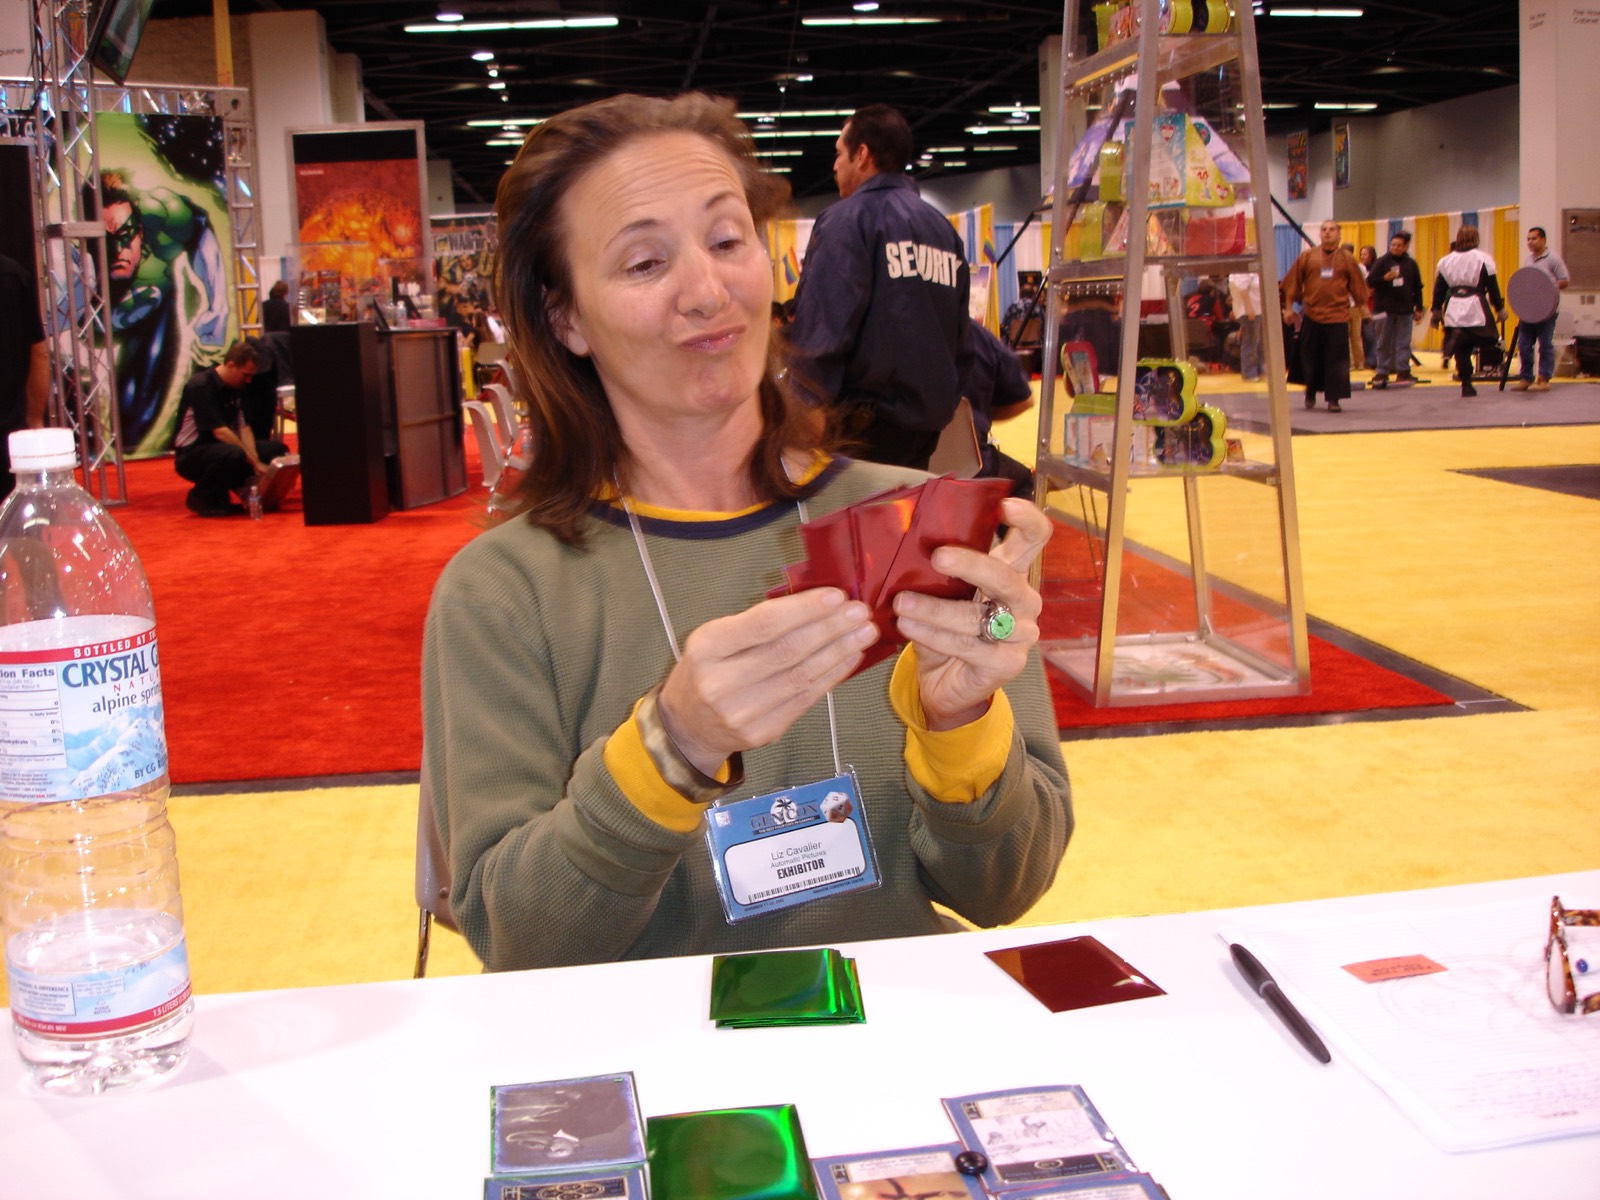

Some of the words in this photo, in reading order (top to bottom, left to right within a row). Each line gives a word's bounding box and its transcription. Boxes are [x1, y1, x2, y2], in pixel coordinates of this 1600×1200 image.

[73, 640, 131, 658] BOTTLED
[136, 636, 146, 646] AT
[22, 668, 55, 678] Facts
[62, 650, 149, 688] CRYSTAL
[92, 693, 137, 714] alpine
[134, 769, 144, 779] BY
[146, 762, 156, 774] CG
[770, 851, 784, 861] Liz
[786, 841, 822, 857] Cavalier
[770, 856, 801, 869] Automatic
[801, 850, 827, 861] Pictures
[777, 858, 825, 880] EXHIBITOR
